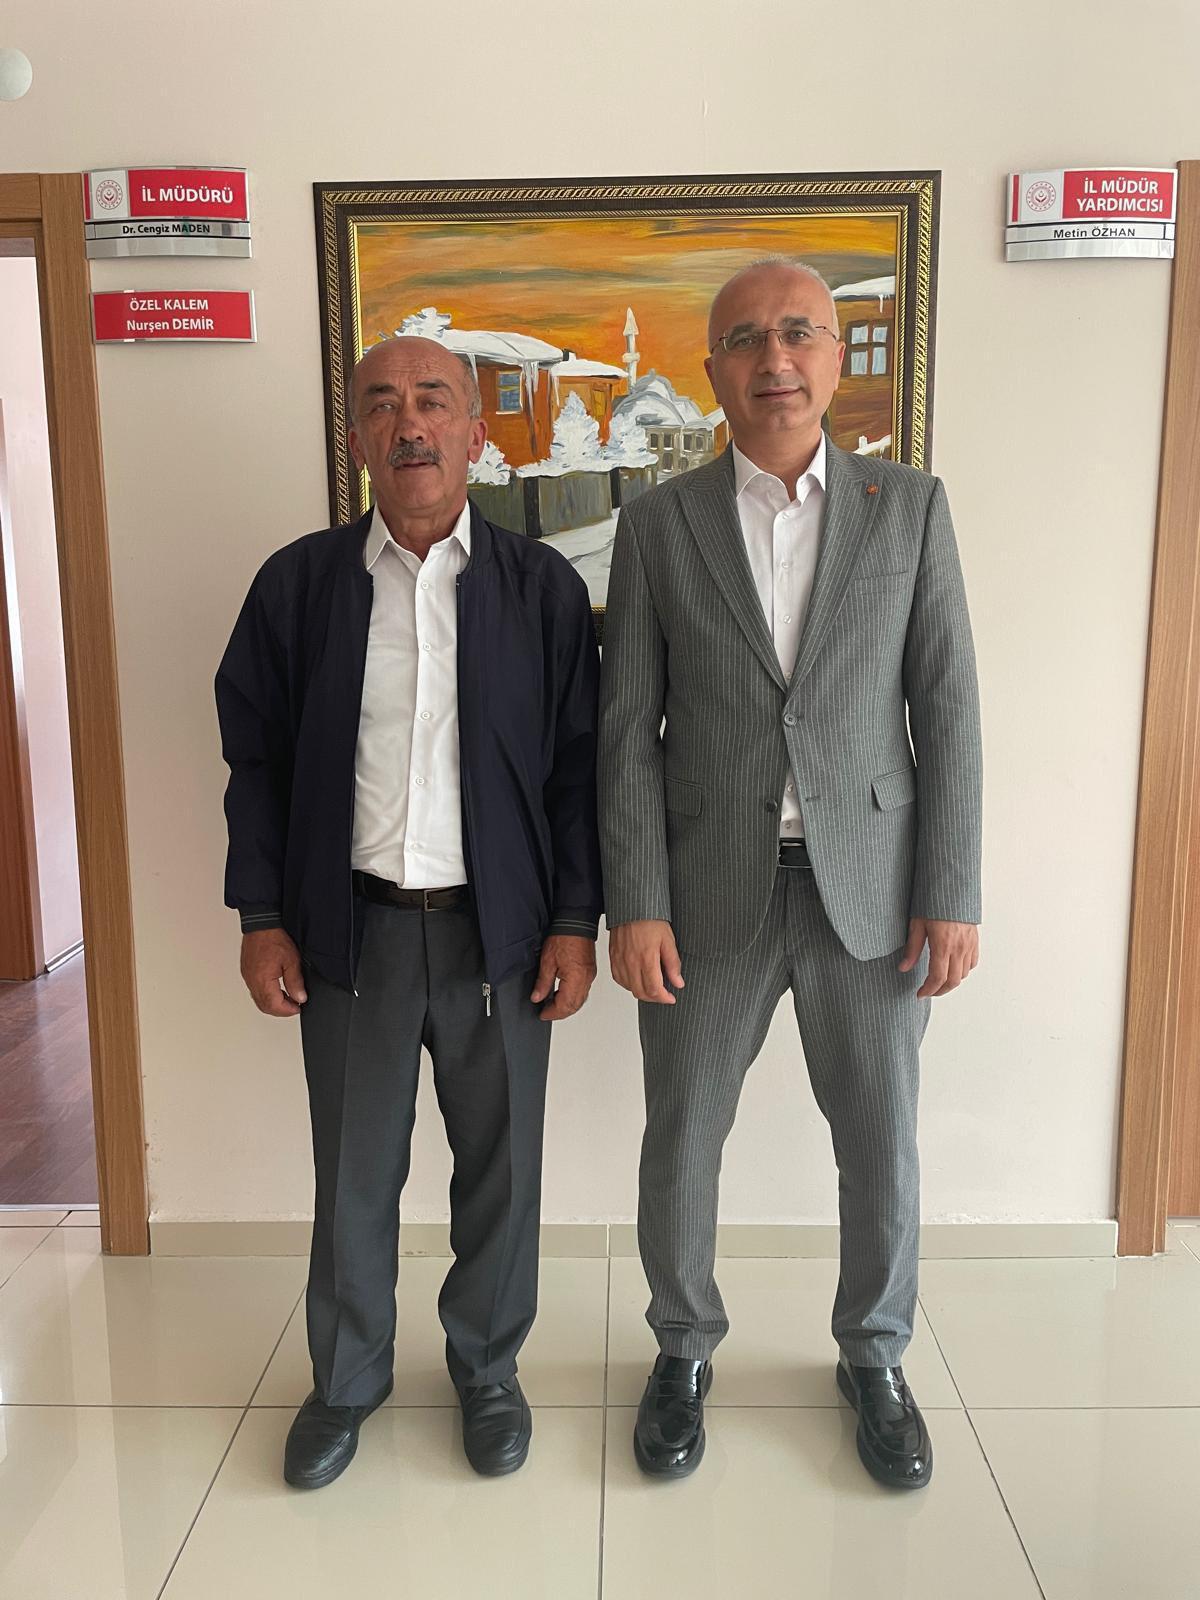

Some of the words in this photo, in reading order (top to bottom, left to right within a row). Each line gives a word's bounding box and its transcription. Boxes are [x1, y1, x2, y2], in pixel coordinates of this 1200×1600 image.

[1084, 177, 1097, 194] İL
[1101, 177, 1158, 194] MÜDÜR
[141, 185, 156, 202] İL
[159, 184, 234, 204] MÜDÜRÜ
[1077, 198, 1163, 213] YARDIMCISI
[122, 225, 136, 234] Dr.
[138, 224, 170, 236] Cengiz
[172, 224, 210, 233] MADEN
[1053, 228, 1088, 239] Metin
[1091, 226, 1136, 237] ÖZHAN
[129, 297, 162, 311] ÖZEL
[164, 299, 209, 311] KALEM
[127, 319, 170, 333] Nurşen
[172, 316, 214, 330] DEMİR
